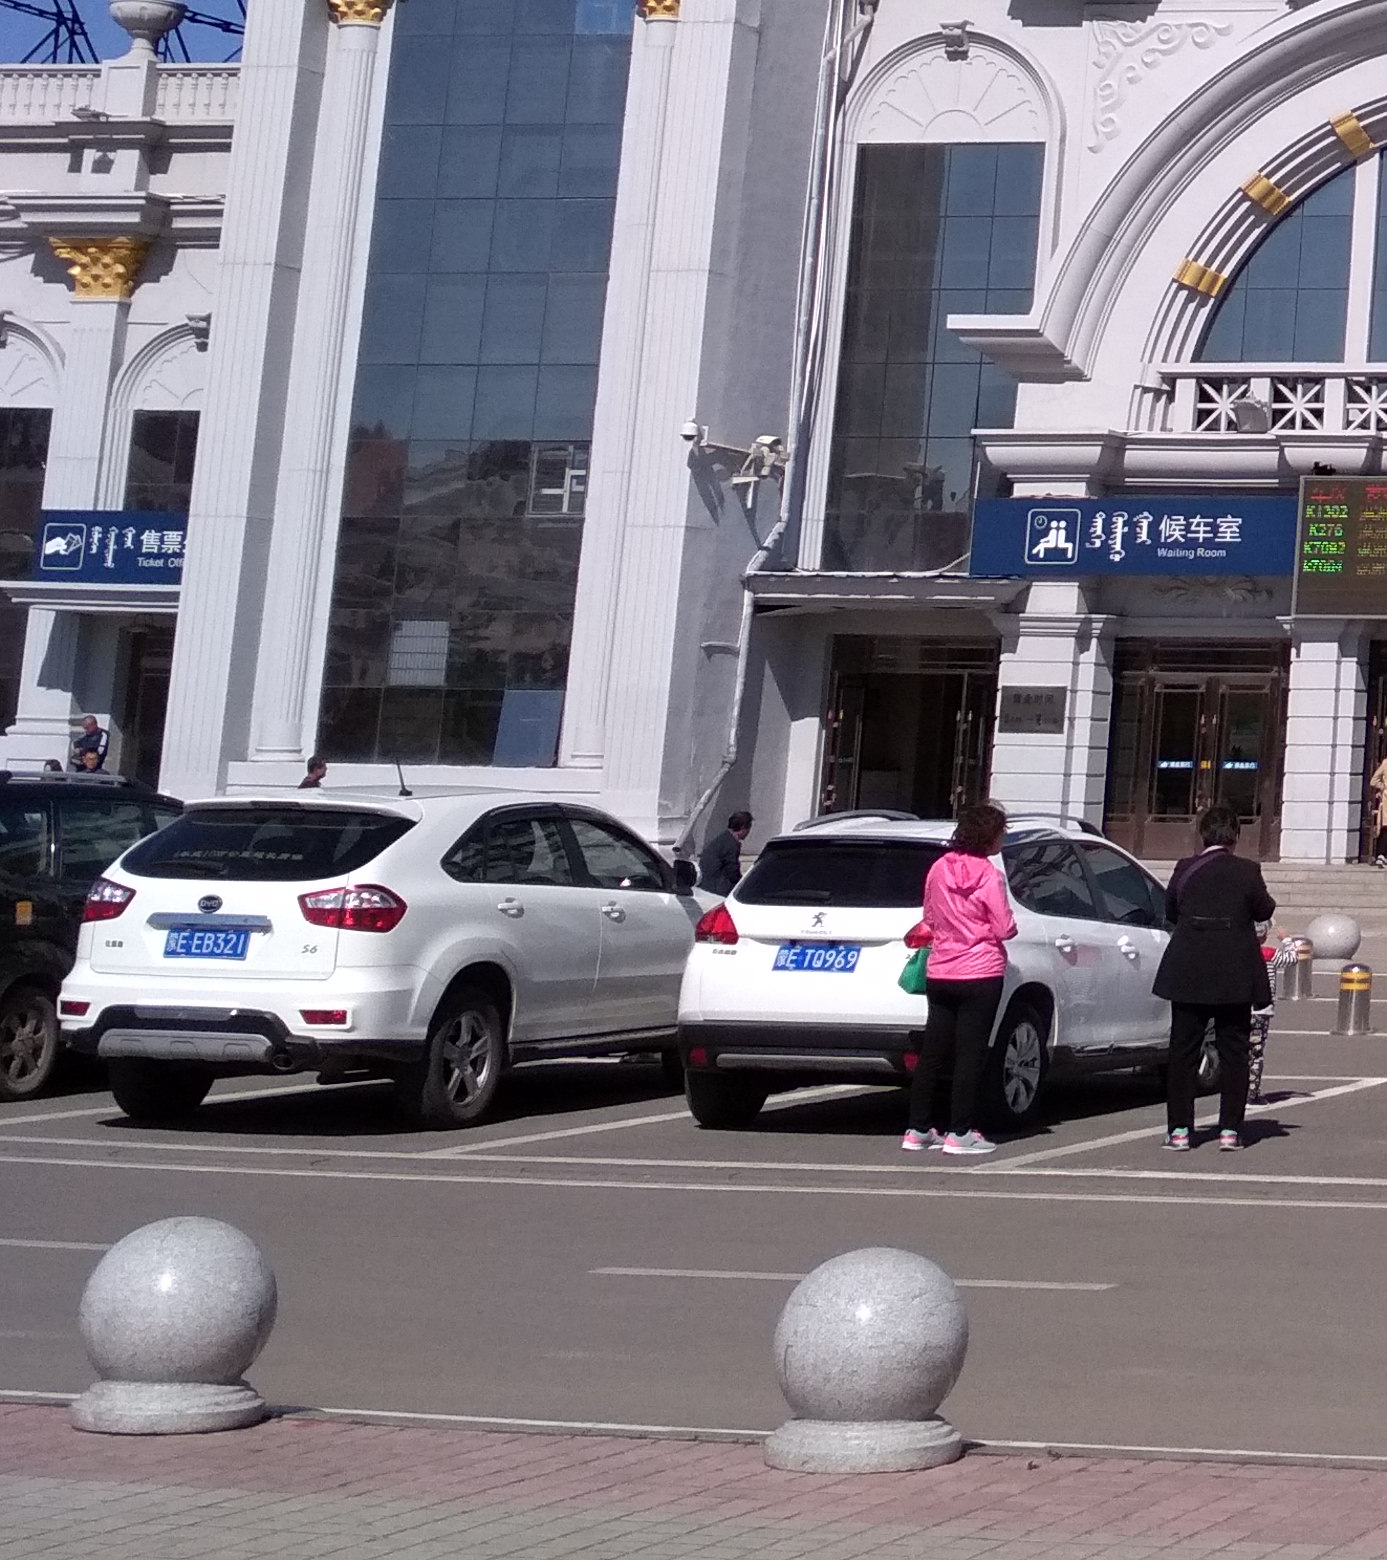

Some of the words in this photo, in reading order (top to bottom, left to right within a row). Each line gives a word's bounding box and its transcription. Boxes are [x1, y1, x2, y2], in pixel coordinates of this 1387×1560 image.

[1159, 514, 1243, 543] 候车室
[140, 529, 186, 554] 售票
[1157, 548, 1194, 559] Waiting
[1196, 547, 1226, 558] Room
[137, 557, 164, 567] Ticket
[301, 944, 318, 954] S6
